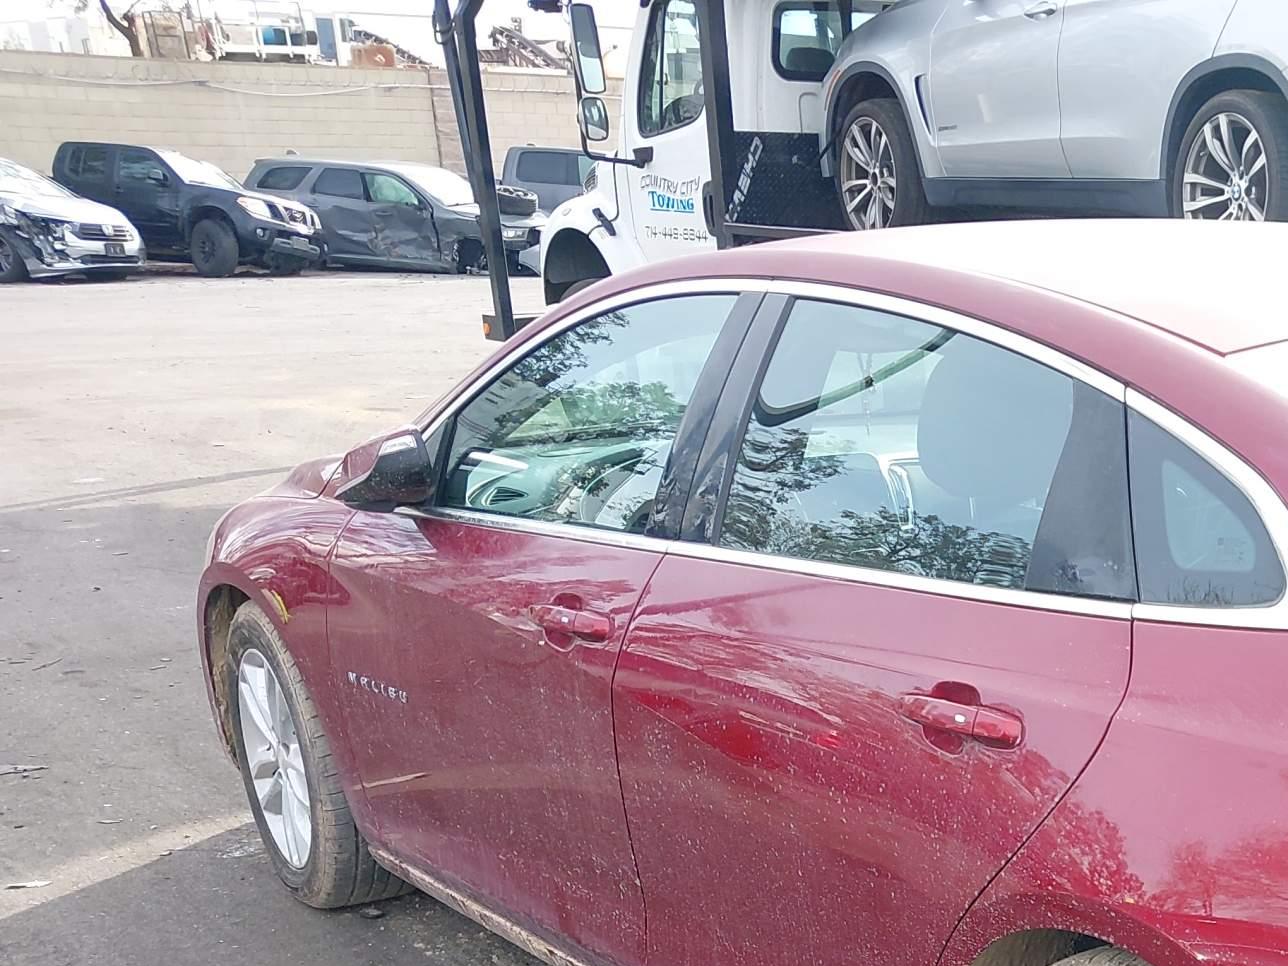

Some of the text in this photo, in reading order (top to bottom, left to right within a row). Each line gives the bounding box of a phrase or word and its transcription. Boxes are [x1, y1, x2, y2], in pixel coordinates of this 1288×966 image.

[640, 173, 701, 195] COUNTRY CITY
[647, 190, 695, 211] TOWING
[346, 671, 408, 704] MALIBU
